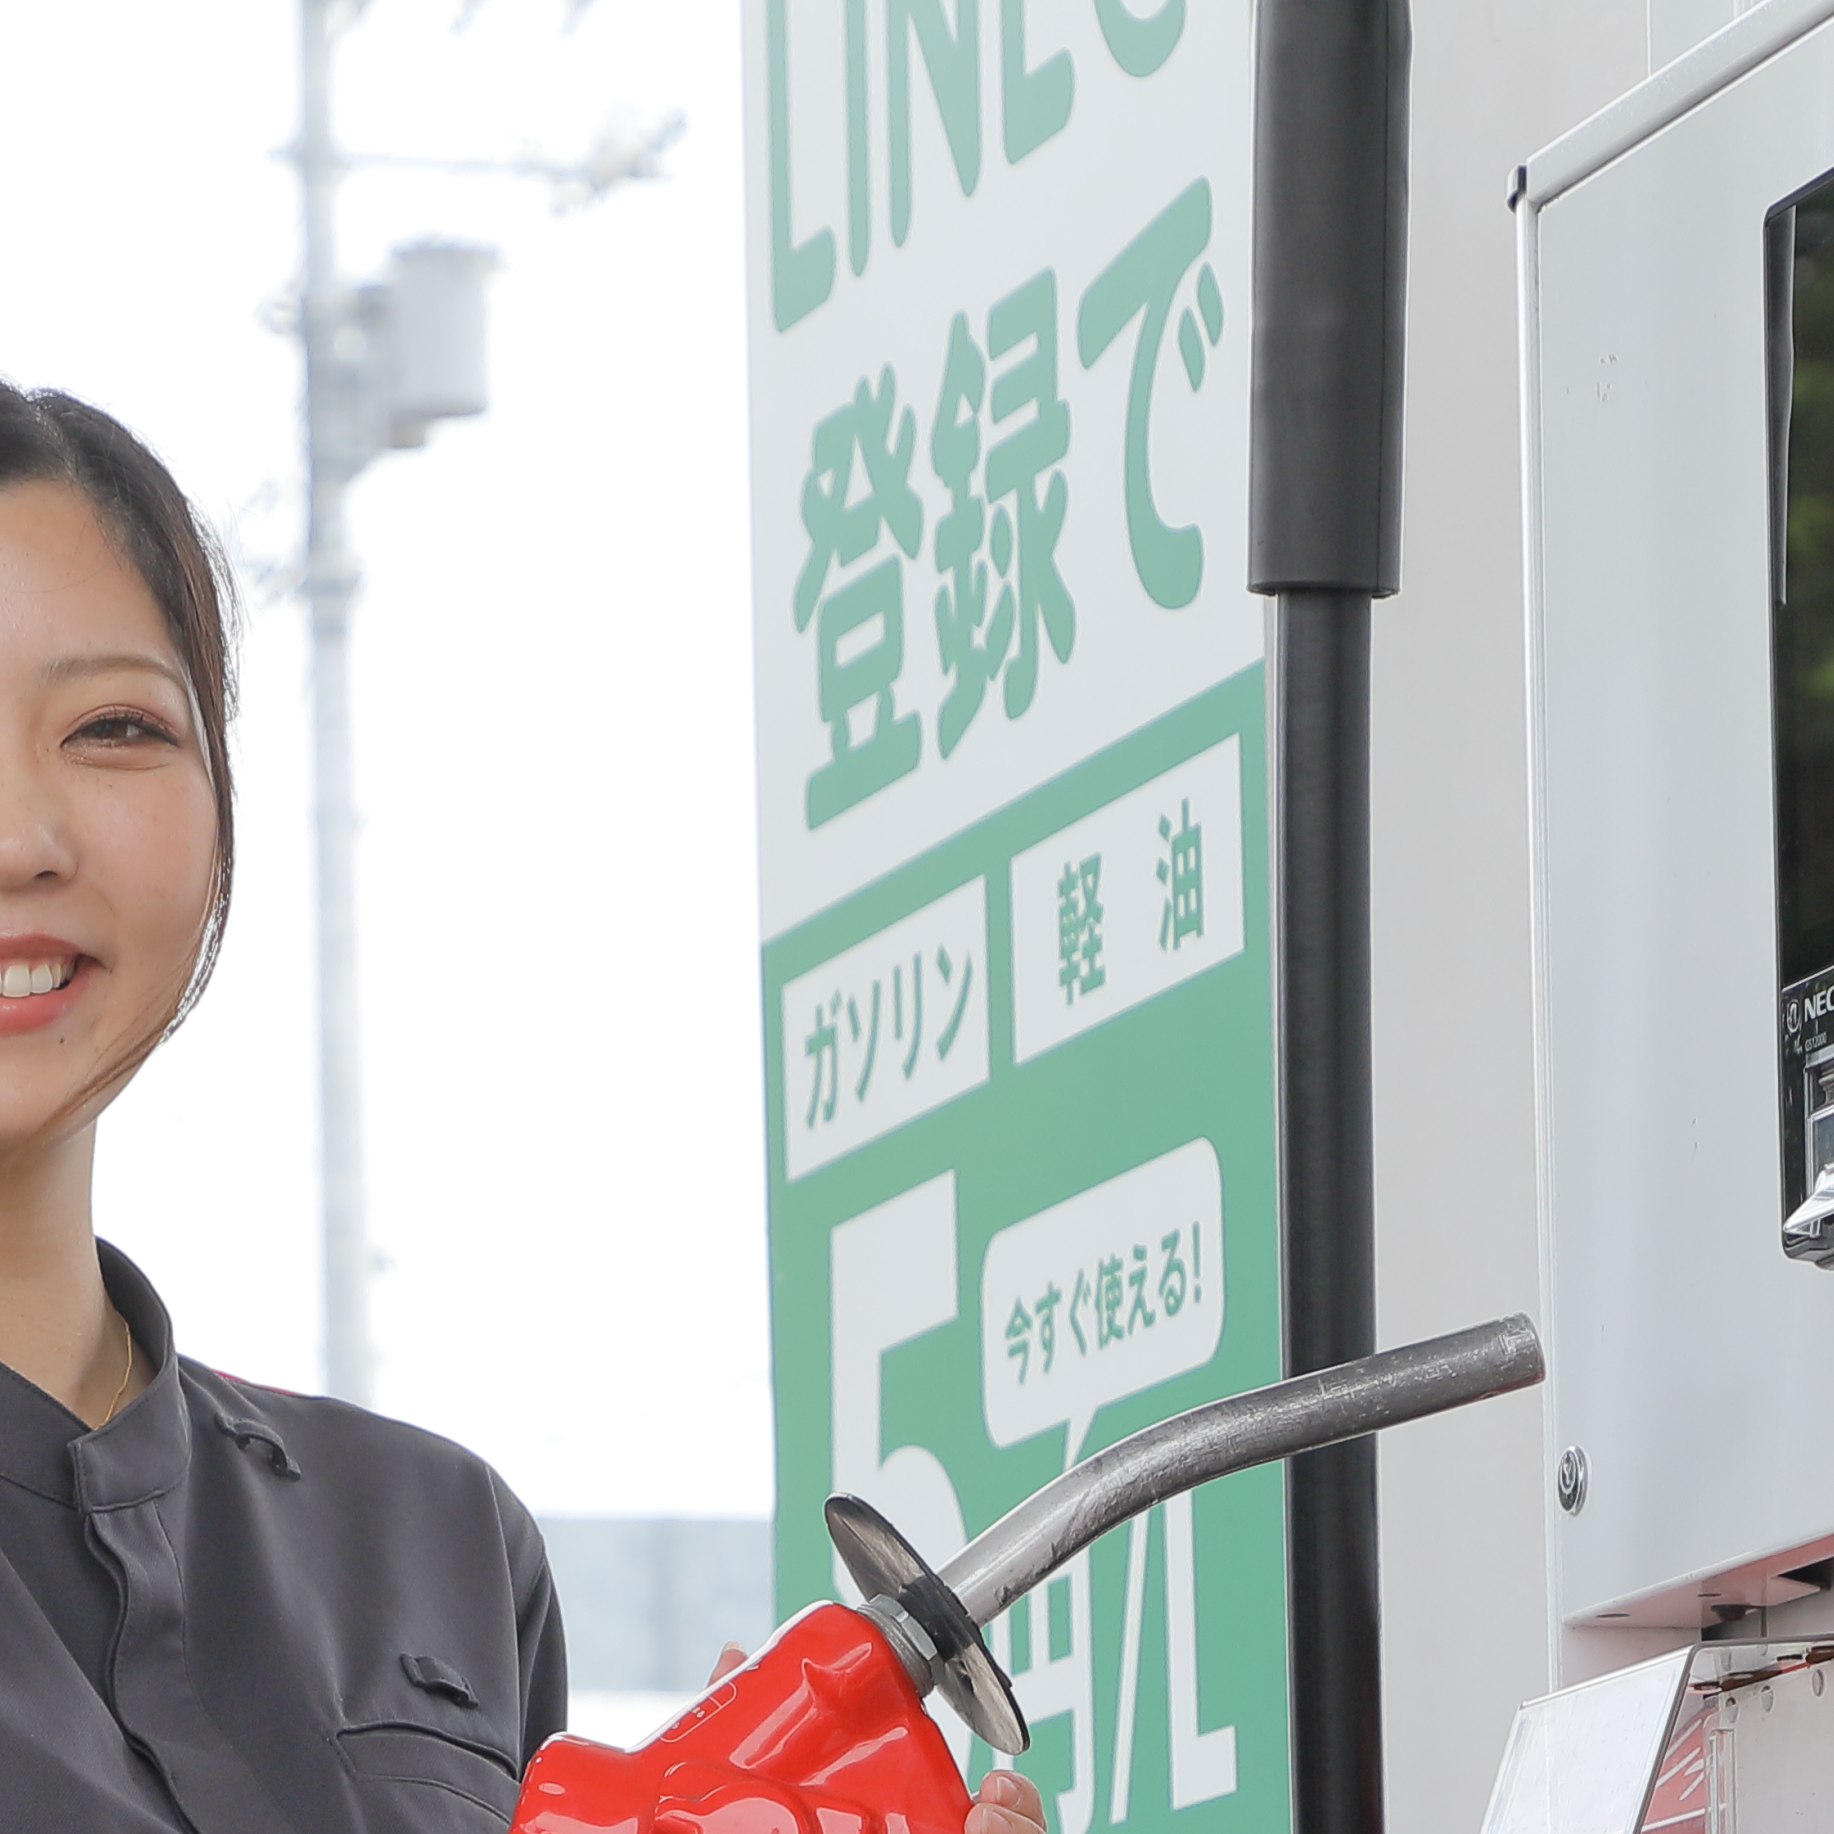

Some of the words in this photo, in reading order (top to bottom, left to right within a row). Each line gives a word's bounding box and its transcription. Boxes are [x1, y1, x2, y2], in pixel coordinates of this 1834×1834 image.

[794, 176, 1223, 830] 登録で
[805, 944, 973, 1128] ガソリン
